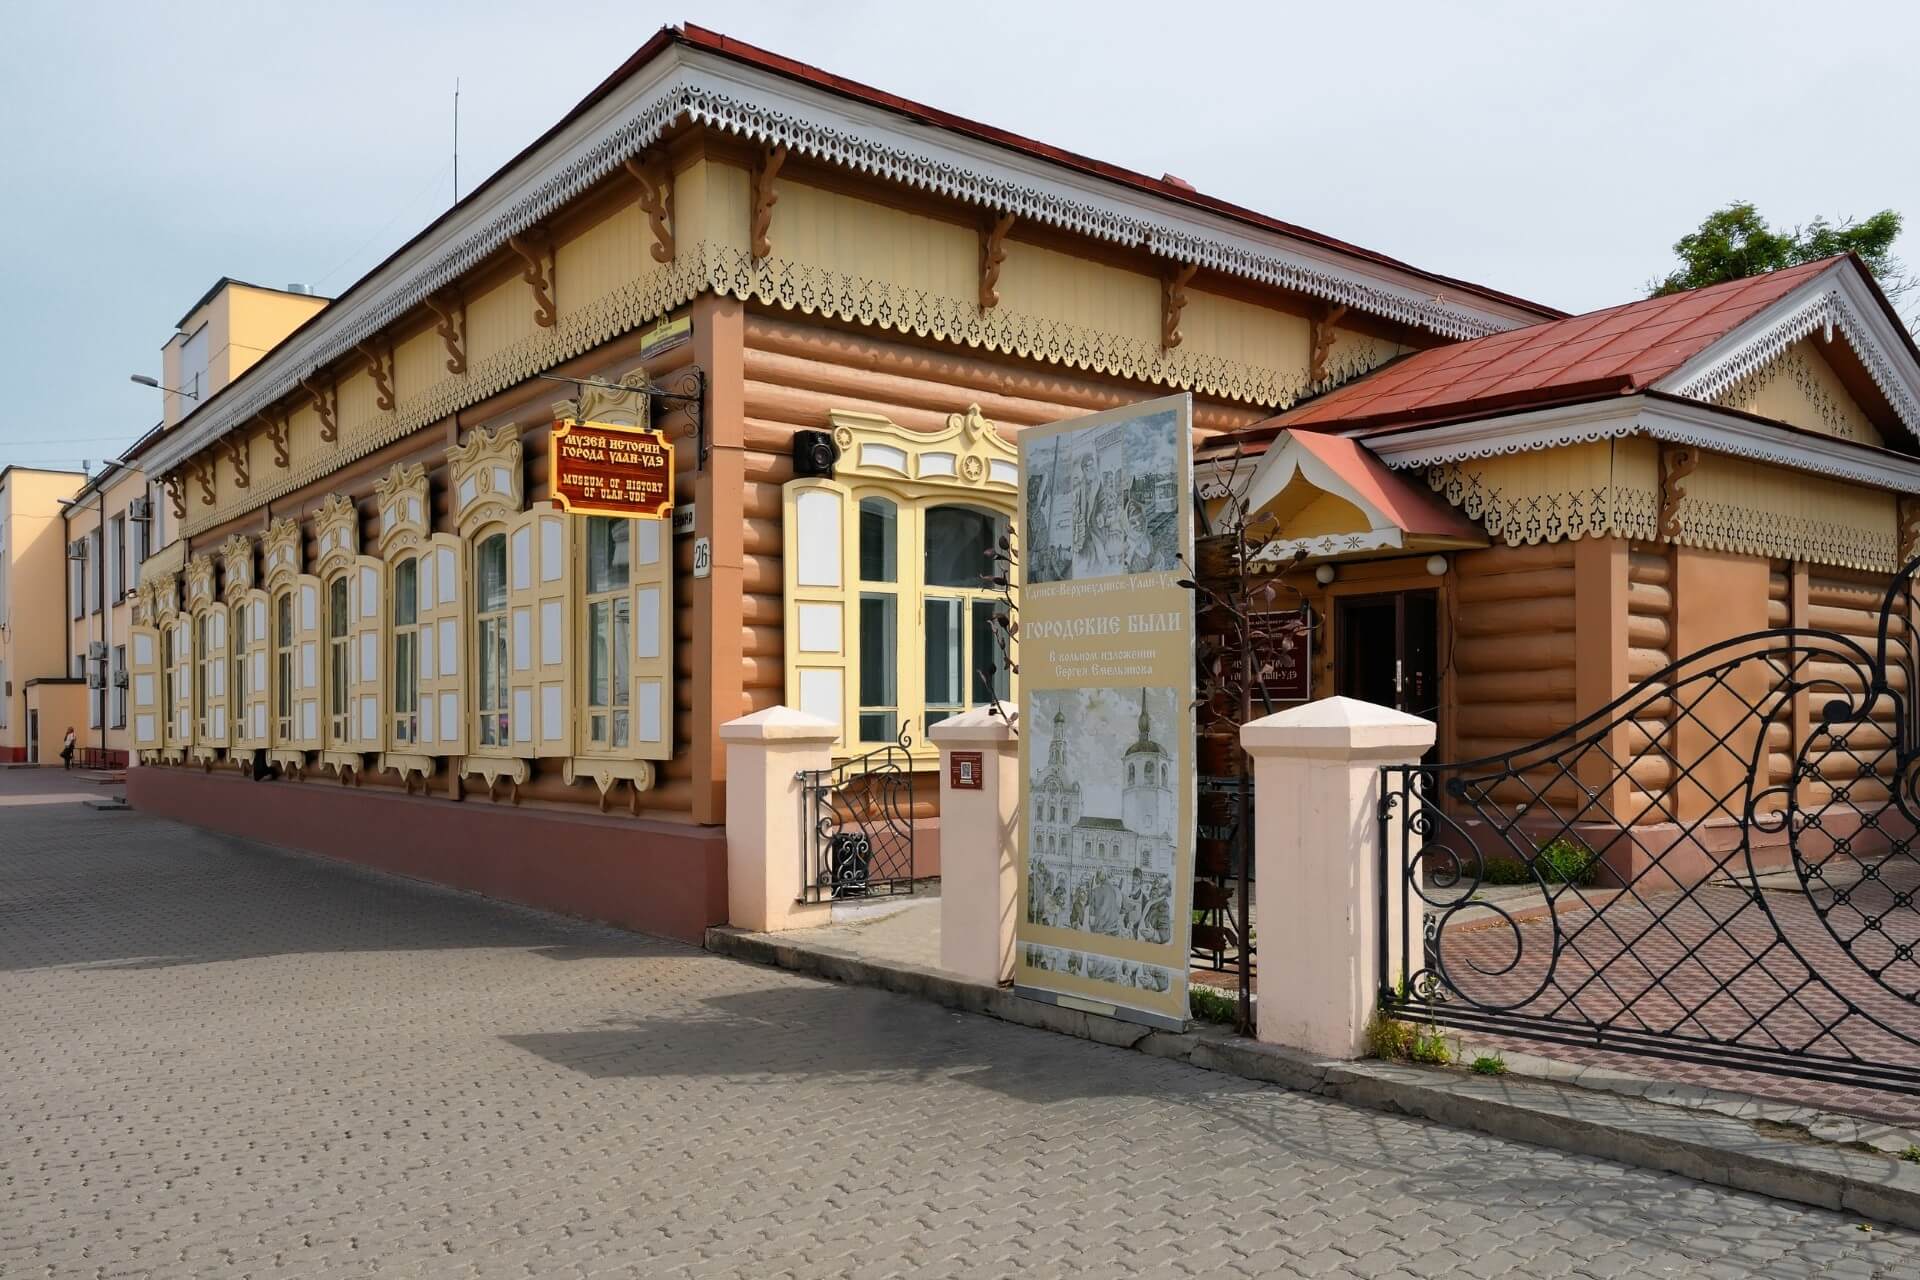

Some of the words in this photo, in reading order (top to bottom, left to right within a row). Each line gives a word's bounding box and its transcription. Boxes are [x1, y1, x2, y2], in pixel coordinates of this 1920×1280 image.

[564, 434, 606, 449] МУЗЕЙ
[609, 439, 660, 454] ИСТОРИИ
[562, 446, 605, 461] ГОРОДА
[609, 451, 664, 468] УЛАН-УДЭ
[563, 473, 604, 487] MUSEUM
[609, 478, 620, 489] OF
[626, 480, 663, 493] HISTORY
[584, 487, 595, 498] OF
[600, 488, 646, 503] ULAN-UDE
[695, 543, 708, 569] 26
[1025, 615, 1121, 641] ГОРОДСКИЕ
[1127, 612, 1184, 633] БЫЛИ
